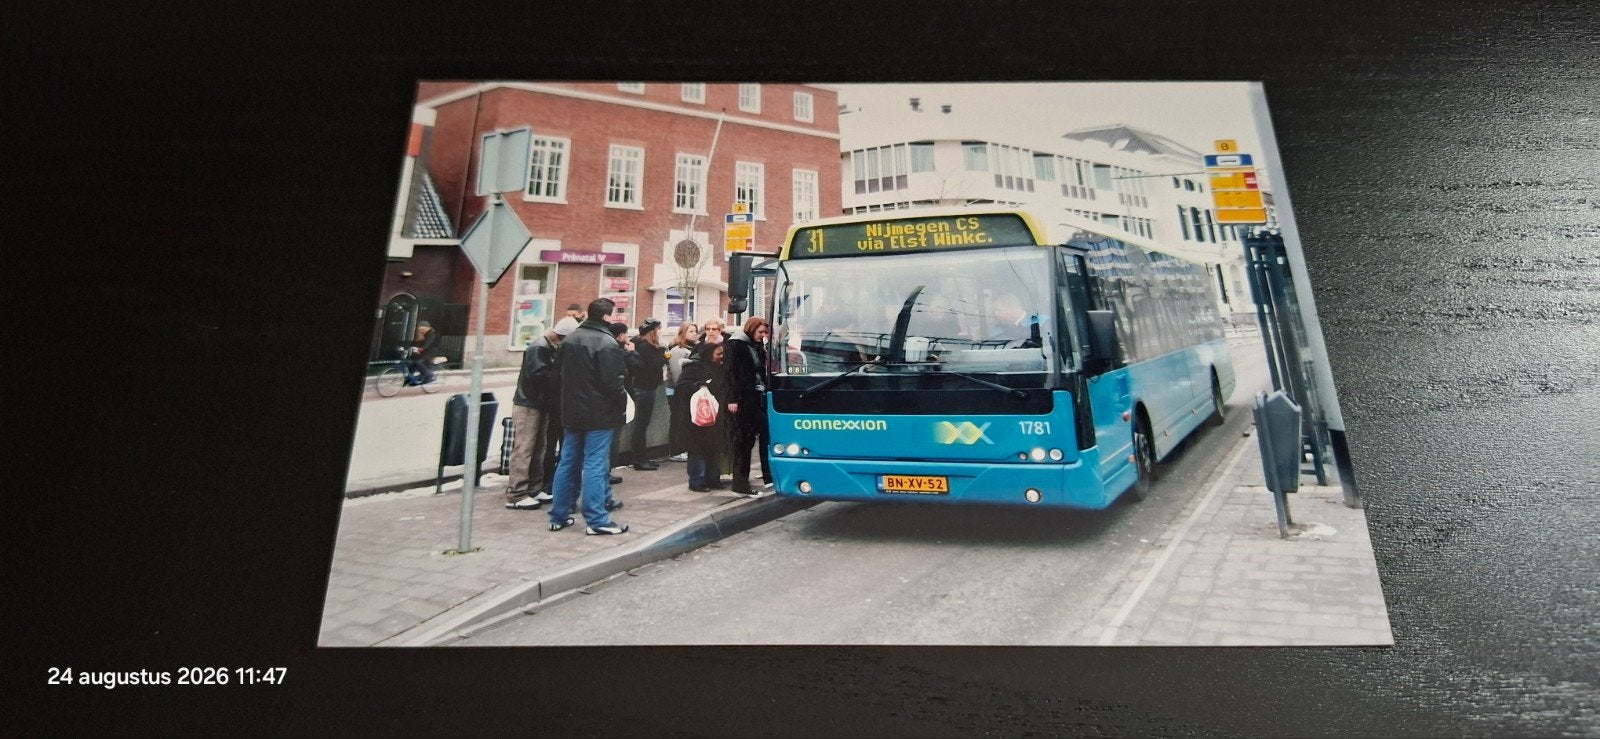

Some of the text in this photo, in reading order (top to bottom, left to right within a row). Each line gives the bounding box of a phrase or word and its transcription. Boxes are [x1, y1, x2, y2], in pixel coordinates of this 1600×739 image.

[866, 217, 980, 239] Nijmegen CS
[807, 228, 824, 253] 31
[857, 231, 993, 251] via Elst Winkc.
[794, 418, 887, 431] connexxion
[1018, 420, 1051, 435] 1781
[886, 477, 944, 490] BN-XV-52
